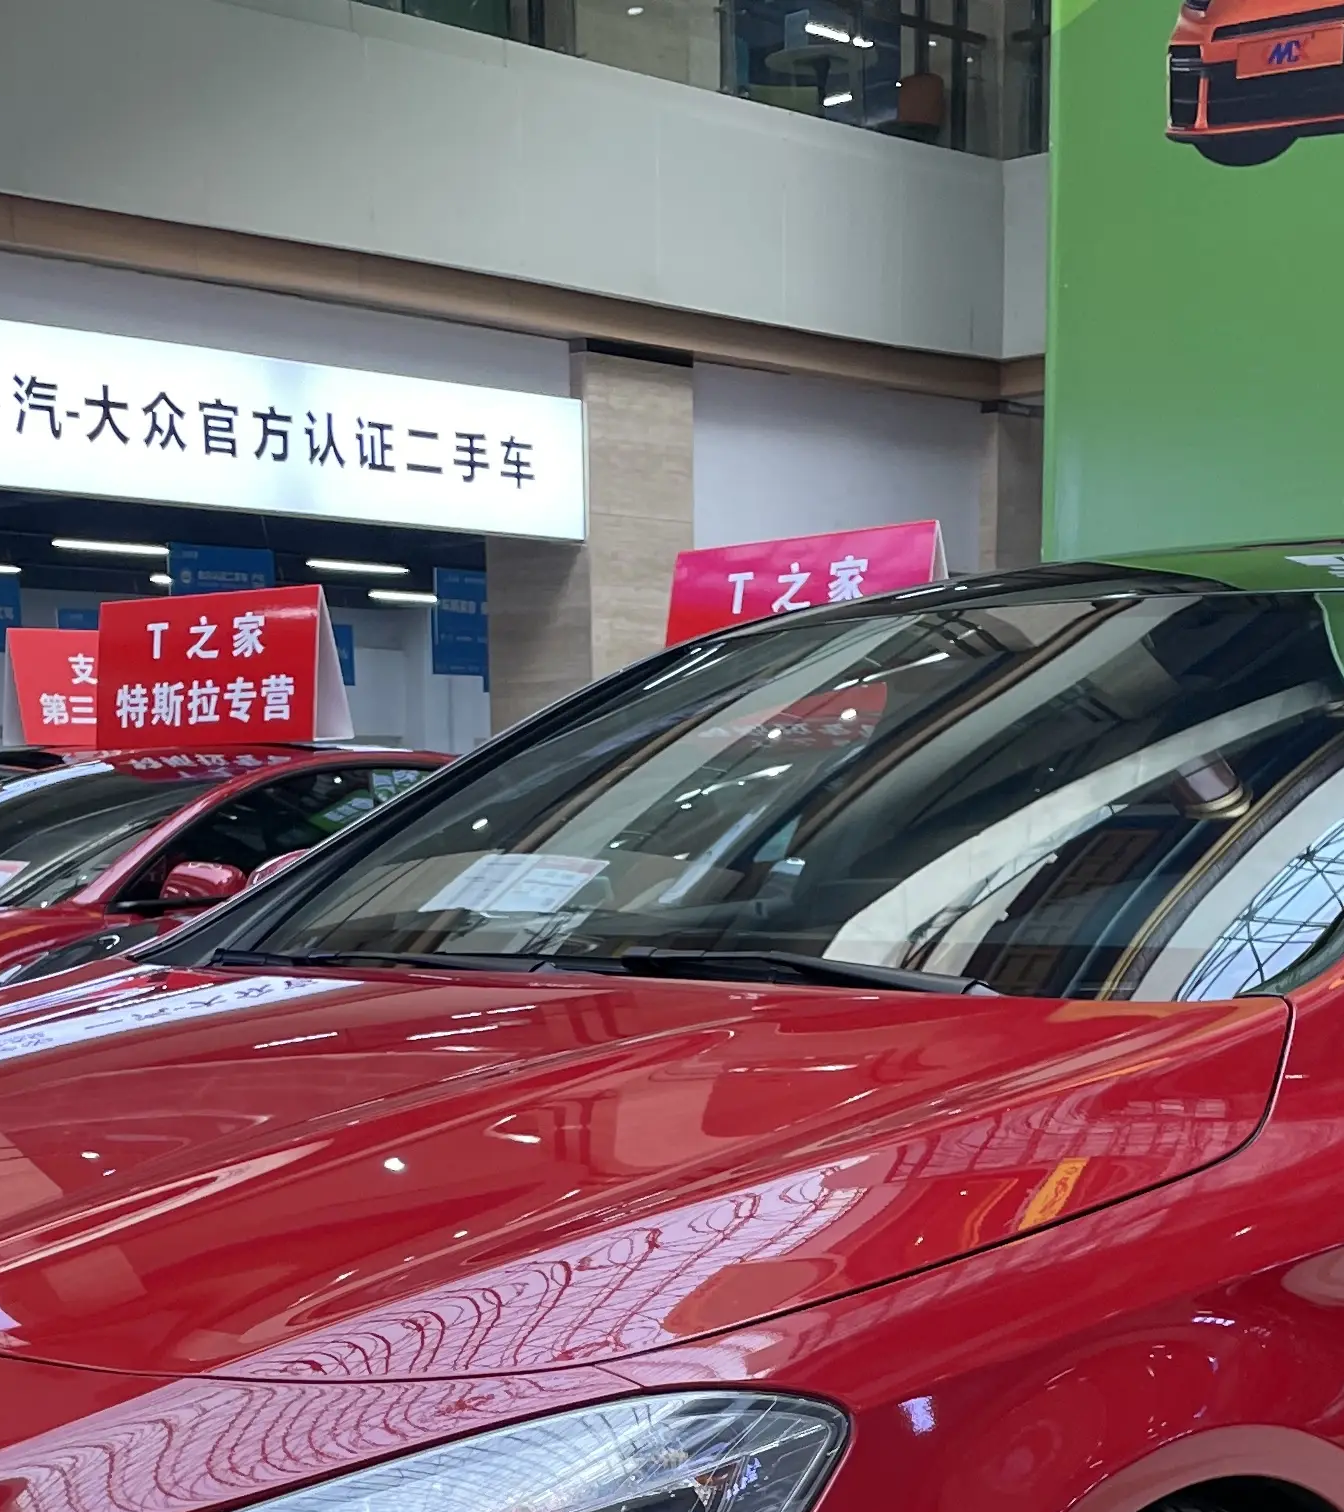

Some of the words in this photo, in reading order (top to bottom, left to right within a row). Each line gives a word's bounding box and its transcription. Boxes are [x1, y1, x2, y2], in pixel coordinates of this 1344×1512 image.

[67, 653, 98, 685] 支
[39, 693, 98, 726] 第三
[115, 673, 296, 730] 特斯拉专营
